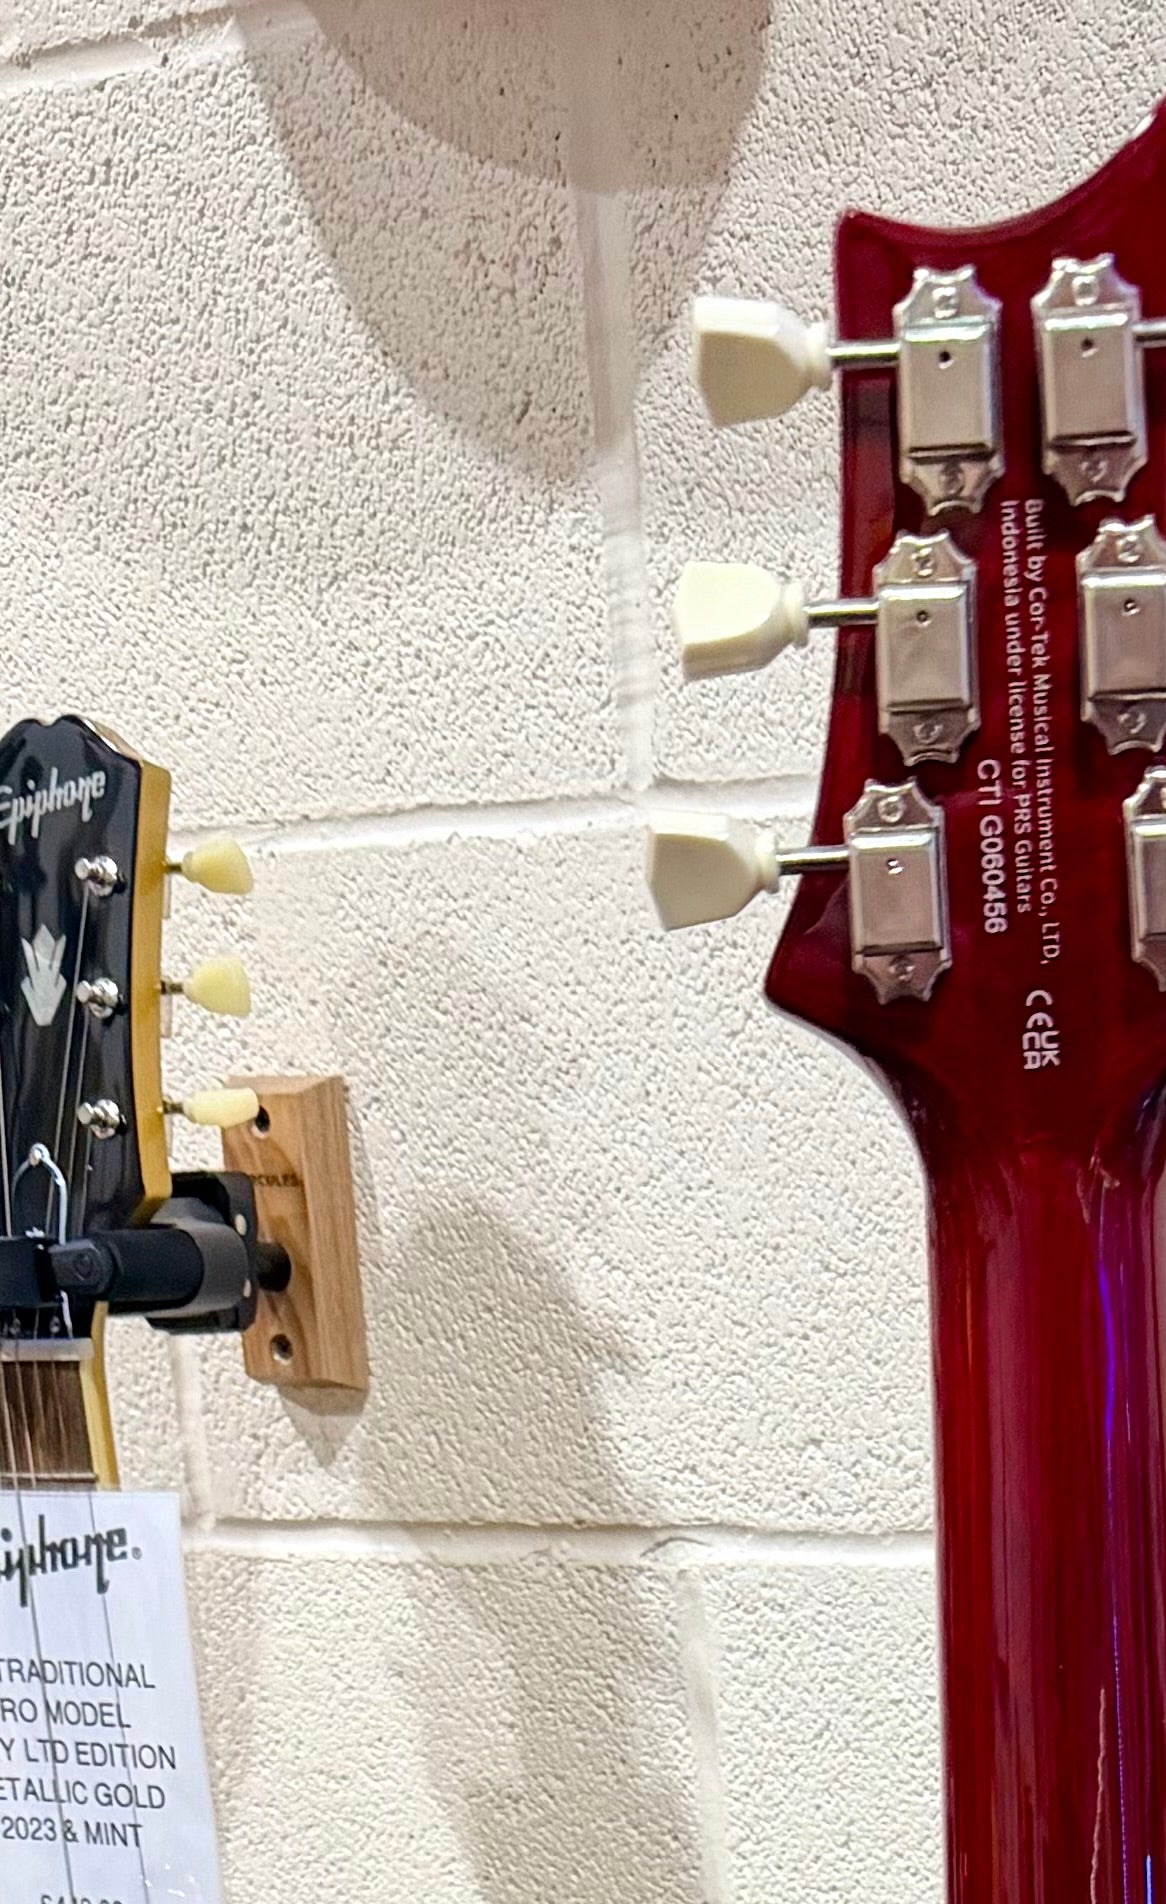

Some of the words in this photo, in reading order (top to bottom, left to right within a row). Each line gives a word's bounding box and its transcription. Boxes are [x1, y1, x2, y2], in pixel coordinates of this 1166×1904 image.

[1024, 498, 1048, 550] Built
[1000, 500, 1024, 607] Indonesia
[1023, 556, 1048, 581] by
[1004, 612, 1027, 675] under
[1028, 587, 1051, 669] Cor-Tek
[1008, 681, 1031, 754] license
[1032, 674, 1055, 753] Musical
[976, 758, 1001, 806] CTI
[1011, 760, 1030, 790] for
[1013, 794, 1033, 835] PRS
[1036, 758, 1058, 872] Instrument
[979, 814, 1008, 934] G060456
[1014, 839, 1034, 913] Guitars
[1038, 877, 1059, 917] Co.,
[0, 1514, 128, 1608] iphone
[46, 1700, 131, 1728] MODEL
[24, 1738, 70, 1765] LTD
[75, 1741, 177, 1770] EDITION
[94, 1782, 166, 1810] GOLD
[2, 1816, 58, 1842] 2023
[63, 1819, 79, 1843] &
[84, 1820, 143, 1848] MINT
